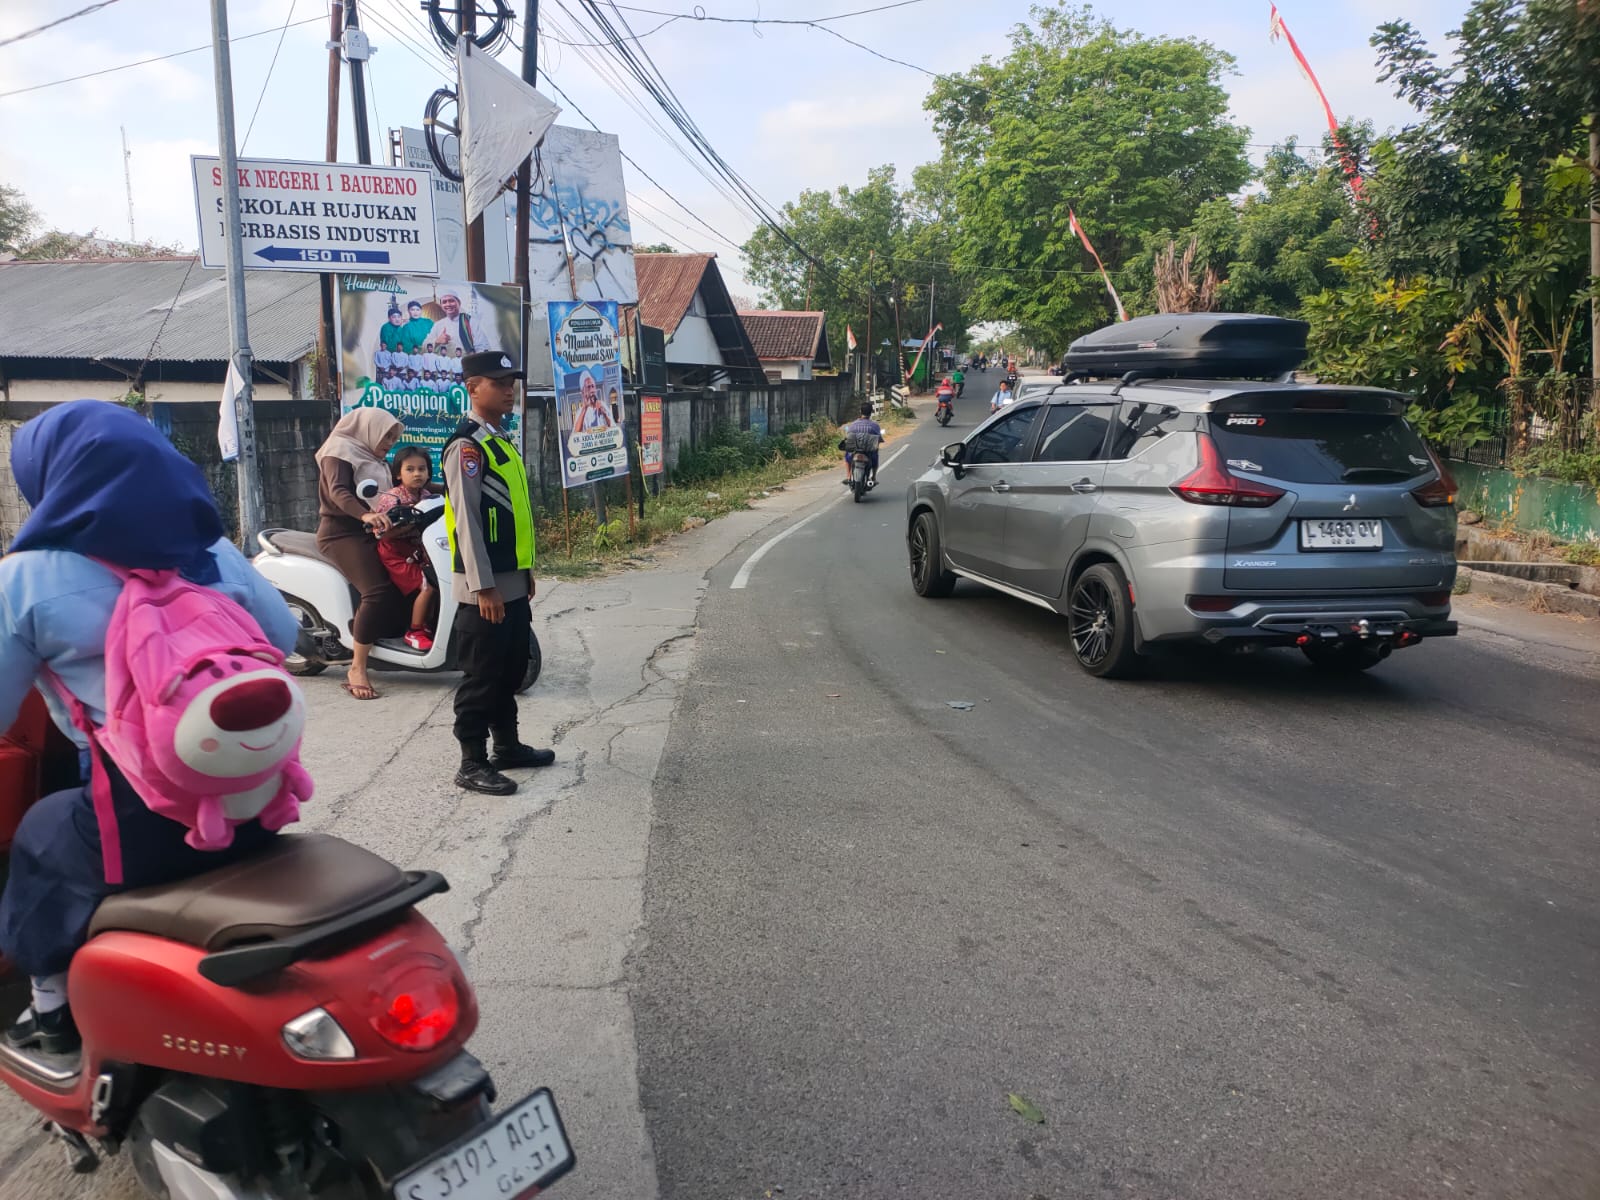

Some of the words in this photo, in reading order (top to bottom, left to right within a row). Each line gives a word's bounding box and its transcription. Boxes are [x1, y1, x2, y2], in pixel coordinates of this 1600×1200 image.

[212, 167, 251, 187] SK
[254, 169, 320, 191] NEGERI
[326, 172, 333, 191] 1
[340, 173, 417, 196] BAURENO
[322, 202, 416, 221] RUJUKAN
[326, 226, 420, 244] INDUSTRI
[298, 248, 332, 262] 150
[340, 251, 357, 263] m
[1226, 417, 1266, 427] PRO7
[1305, 521, 1317, 538] L
[162, 1034, 248, 1062] SCOOPY
[505, 1105, 550, 1150] ACI
